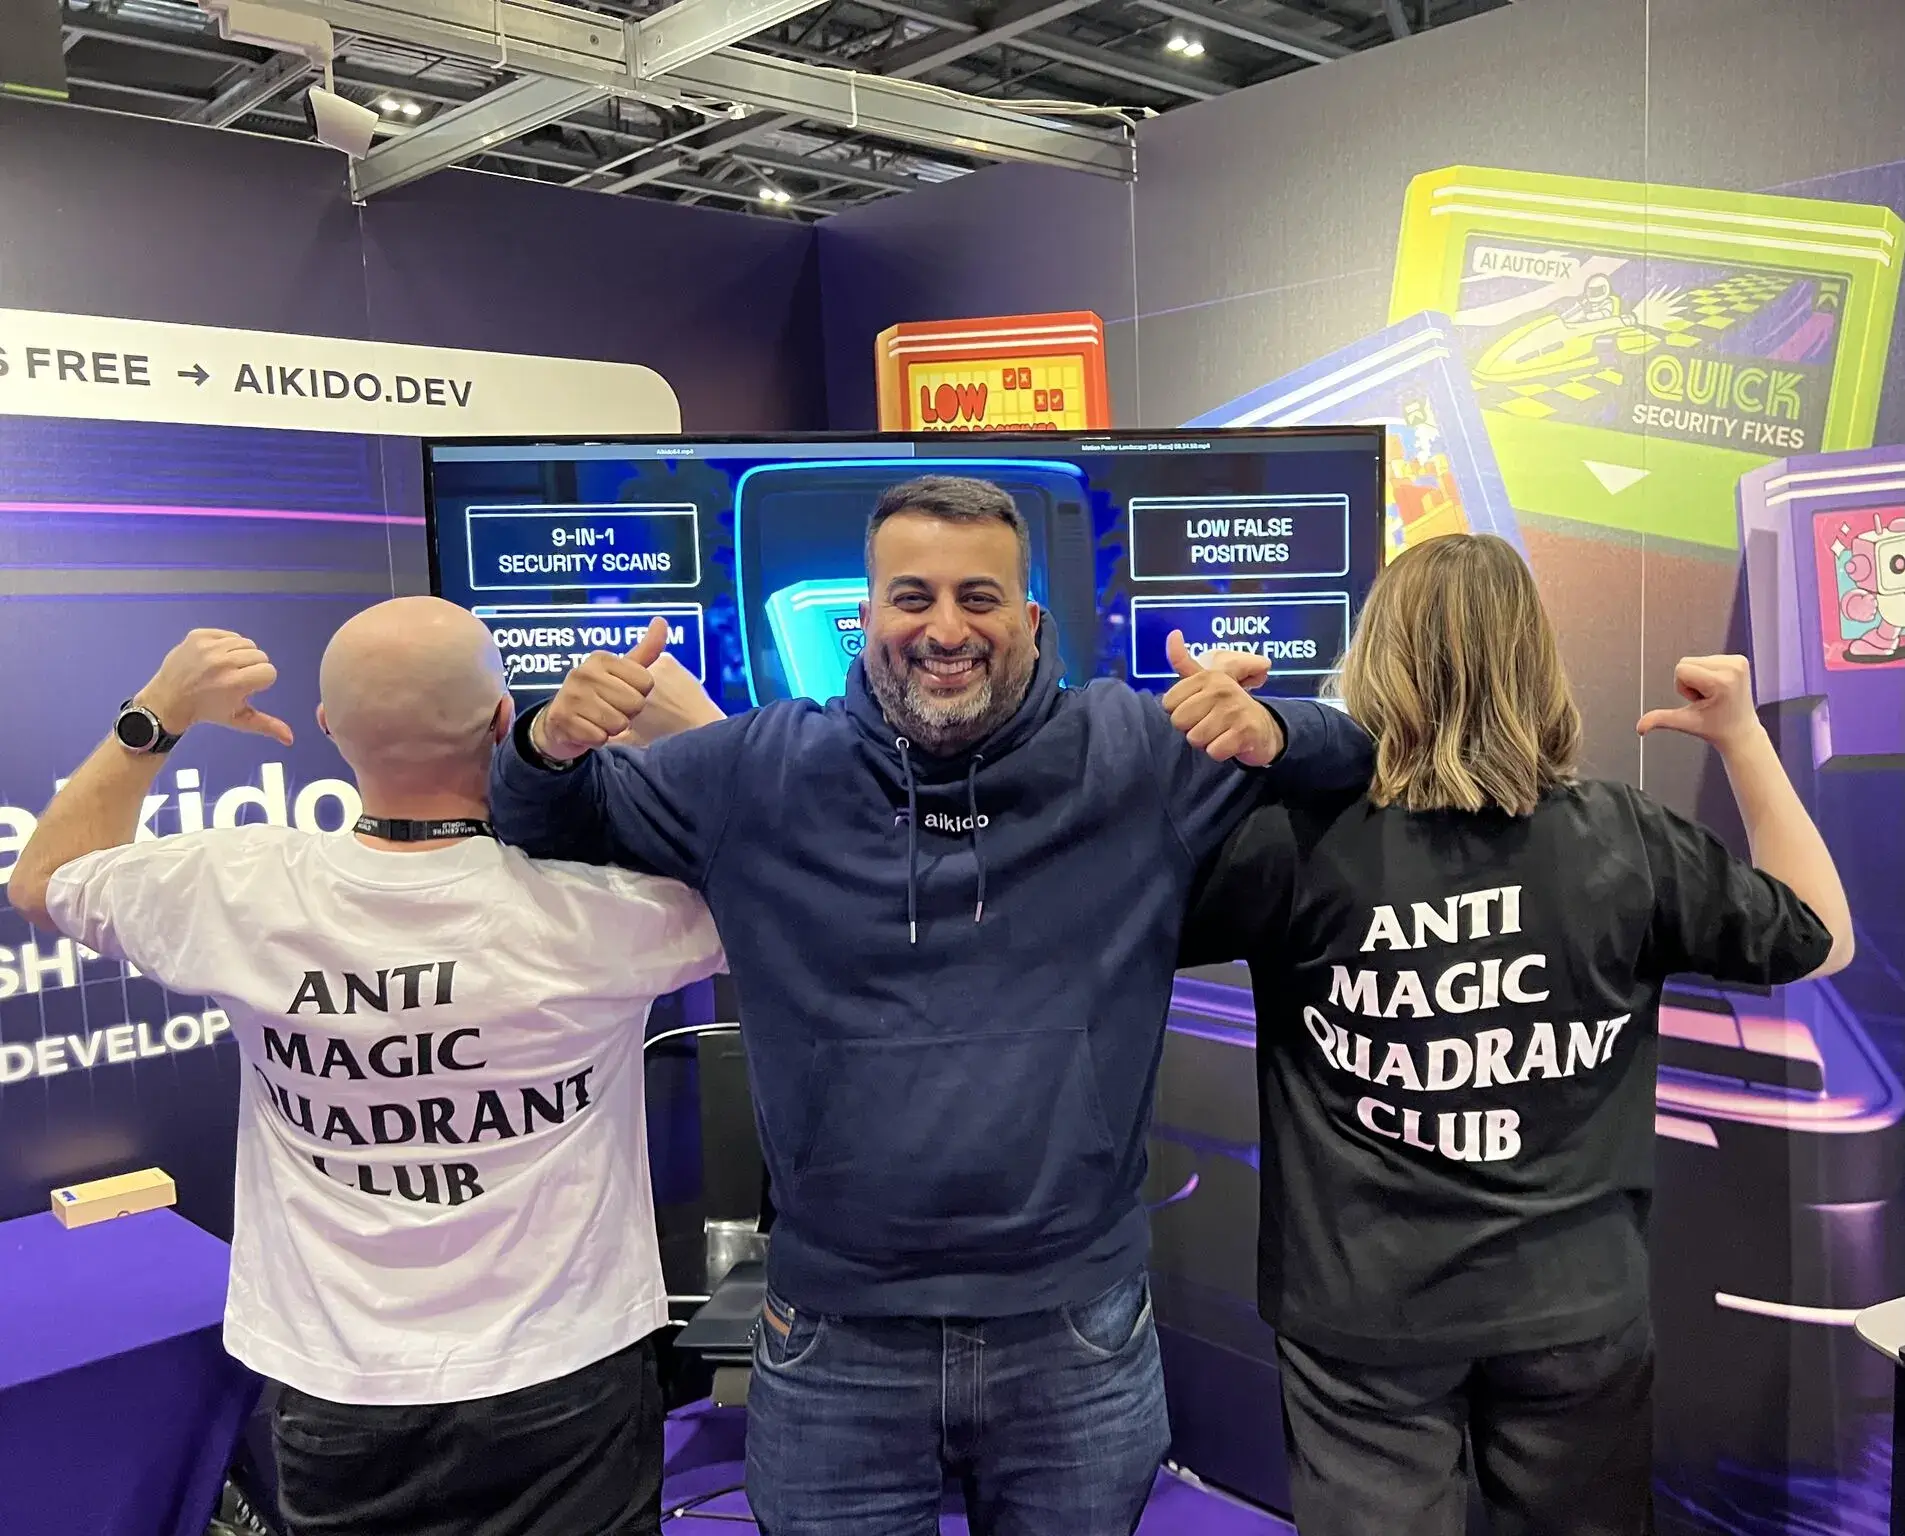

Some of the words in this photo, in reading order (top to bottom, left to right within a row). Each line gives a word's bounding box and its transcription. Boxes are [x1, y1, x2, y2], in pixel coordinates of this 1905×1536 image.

[1480, 252, 1498, 270] AI
[1500, 256, 1573, 279] AUTOFIX
[26, 347, 151, 386] FREE
[234, 363, 472, 408] AIKIDO.DEV
[1646, 354, 1804, 420] QUICK
[921, 383, 988, 423] LOW
[1632, 404, 1738, 438] SECURITY
[1741, 421, 1805, 450] FIXES
[551, 527, 615, 547] 9-IN-1
[1186, 519, 1230, 539] LOW
[1233, 517, 1294, 537] FALSE
[498, 553, 598, 573] SECURITY
[601, 552, 672, 572] SCANS
[1191, 543, 1290, 564] POSITIVES
[492, 627, 575, 648] COVERS
[577, 626, 621, 646] YOU
[624, 625, 684, 646] FM
[1211, 615, 1271, 639] QUICK
[1262, 639, 1317, 659] FIXES
[924, 812, 989, 832] aikido
[1359, 885, 1522, 952] ANTI
[286, 960, 457, 1014] ANTI
[1328, 954, 1550, 1018] MAGIC
[263, 1026, 487, 1080] MAGIC
[1303, 1005, 1632, 1091] QUADRANT
[1356, 1096, 1522, 1162] CLUB
